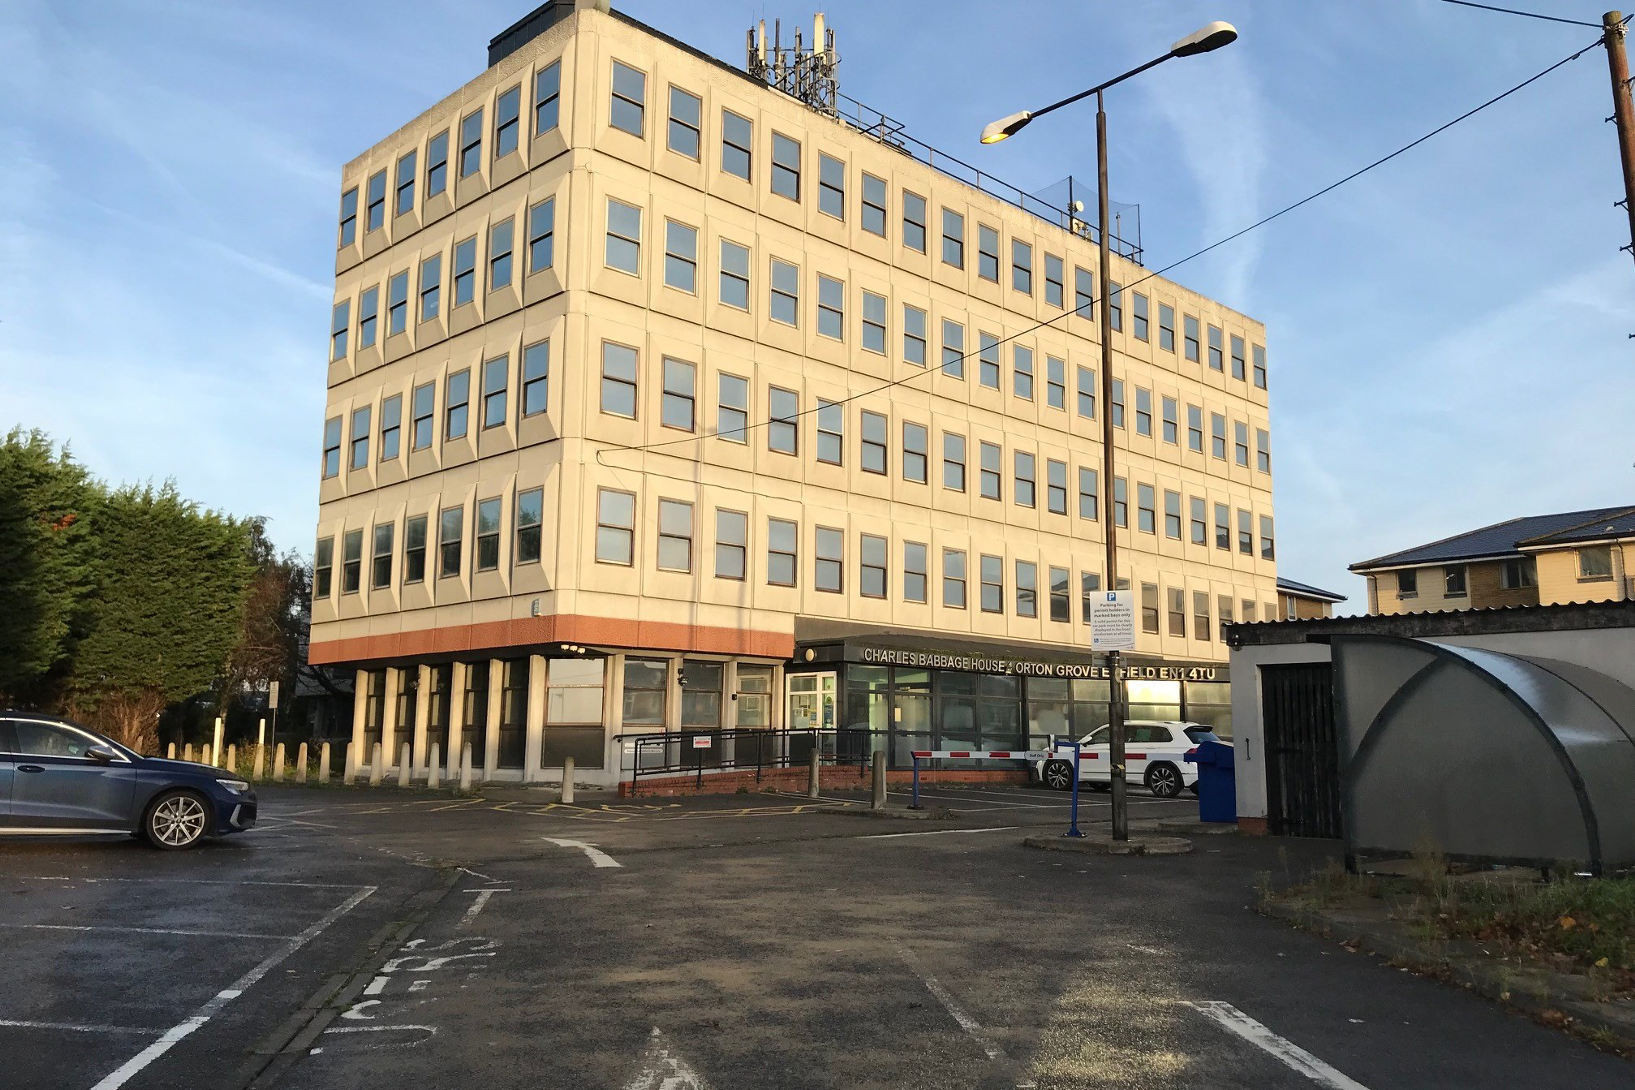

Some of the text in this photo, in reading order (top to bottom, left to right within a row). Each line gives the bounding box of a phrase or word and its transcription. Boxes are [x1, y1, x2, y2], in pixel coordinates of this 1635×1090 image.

[864, 648, 917, 665] CHARLES
[918, 653, 969, 670] BABBAGE
[971, 658, 1005, 672] HOUSE
[1015, 661, 1053, 675] ORTON
[1056, 664, 1099, 678] GROVE
[1101, 666, 1156, 679] EFIELD
[1159, 667, 1184, 679] EN1
[1188, 667, 1216, 680] 4TU
